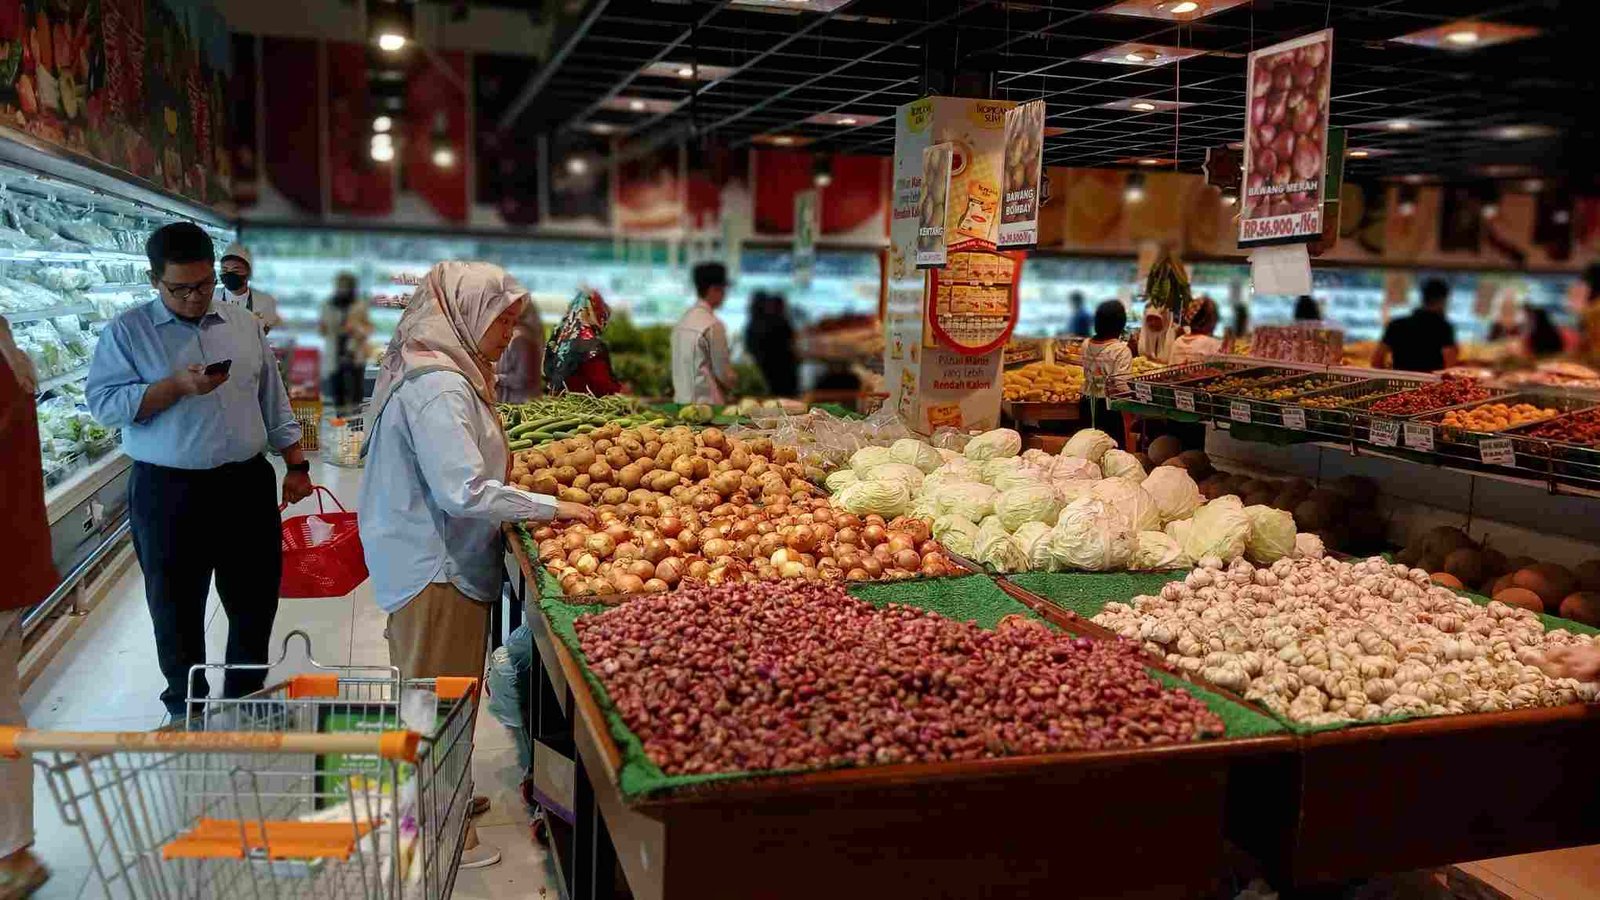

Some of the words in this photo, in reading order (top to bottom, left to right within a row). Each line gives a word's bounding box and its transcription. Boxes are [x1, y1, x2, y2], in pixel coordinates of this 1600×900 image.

[1248, 186, 1285, 196] BAWANG
[1286, 181, 1318, 193] MERAH
[1006, 189, 1034, 202] BAWANG
[1005, 204, 1032, 215] BOMBAY
[919, 226, 944, 236] KENTANG
[933, 380, 965, 389] Rendah
[966, 380, 991, 389] Kalori
